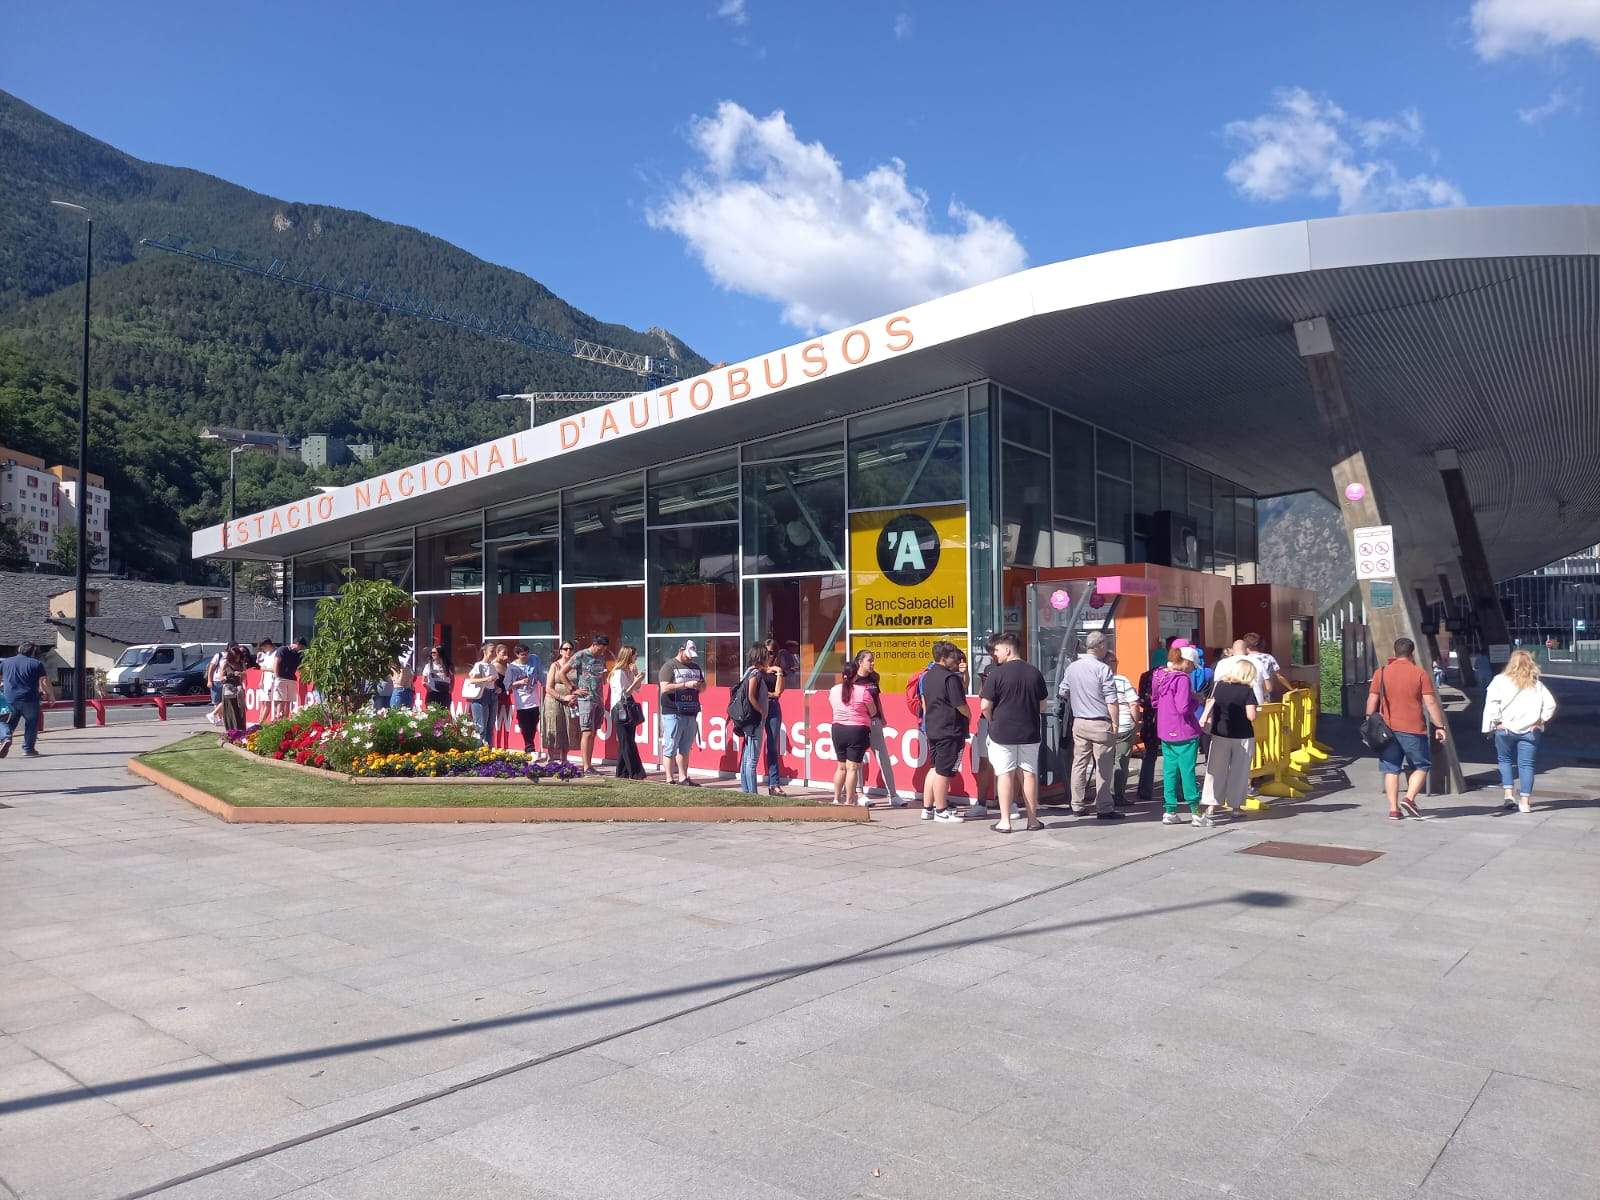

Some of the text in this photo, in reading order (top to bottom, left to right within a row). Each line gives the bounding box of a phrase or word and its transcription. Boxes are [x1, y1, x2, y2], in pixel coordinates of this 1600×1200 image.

[221, 315, 915, 549] ESTACIÓ NACIONAL D'AUTOBUSOS
[865, 595, 955, 611] BancSabadell
[865, 613, 933, 627] d'Andorra
[865, 639, 882, 648] Una
[884, 640, 917, 648] manera
[919, 639, 931, 648] de
[883, 651, 916, 659] manera
[918, 650, 930, 659] de
